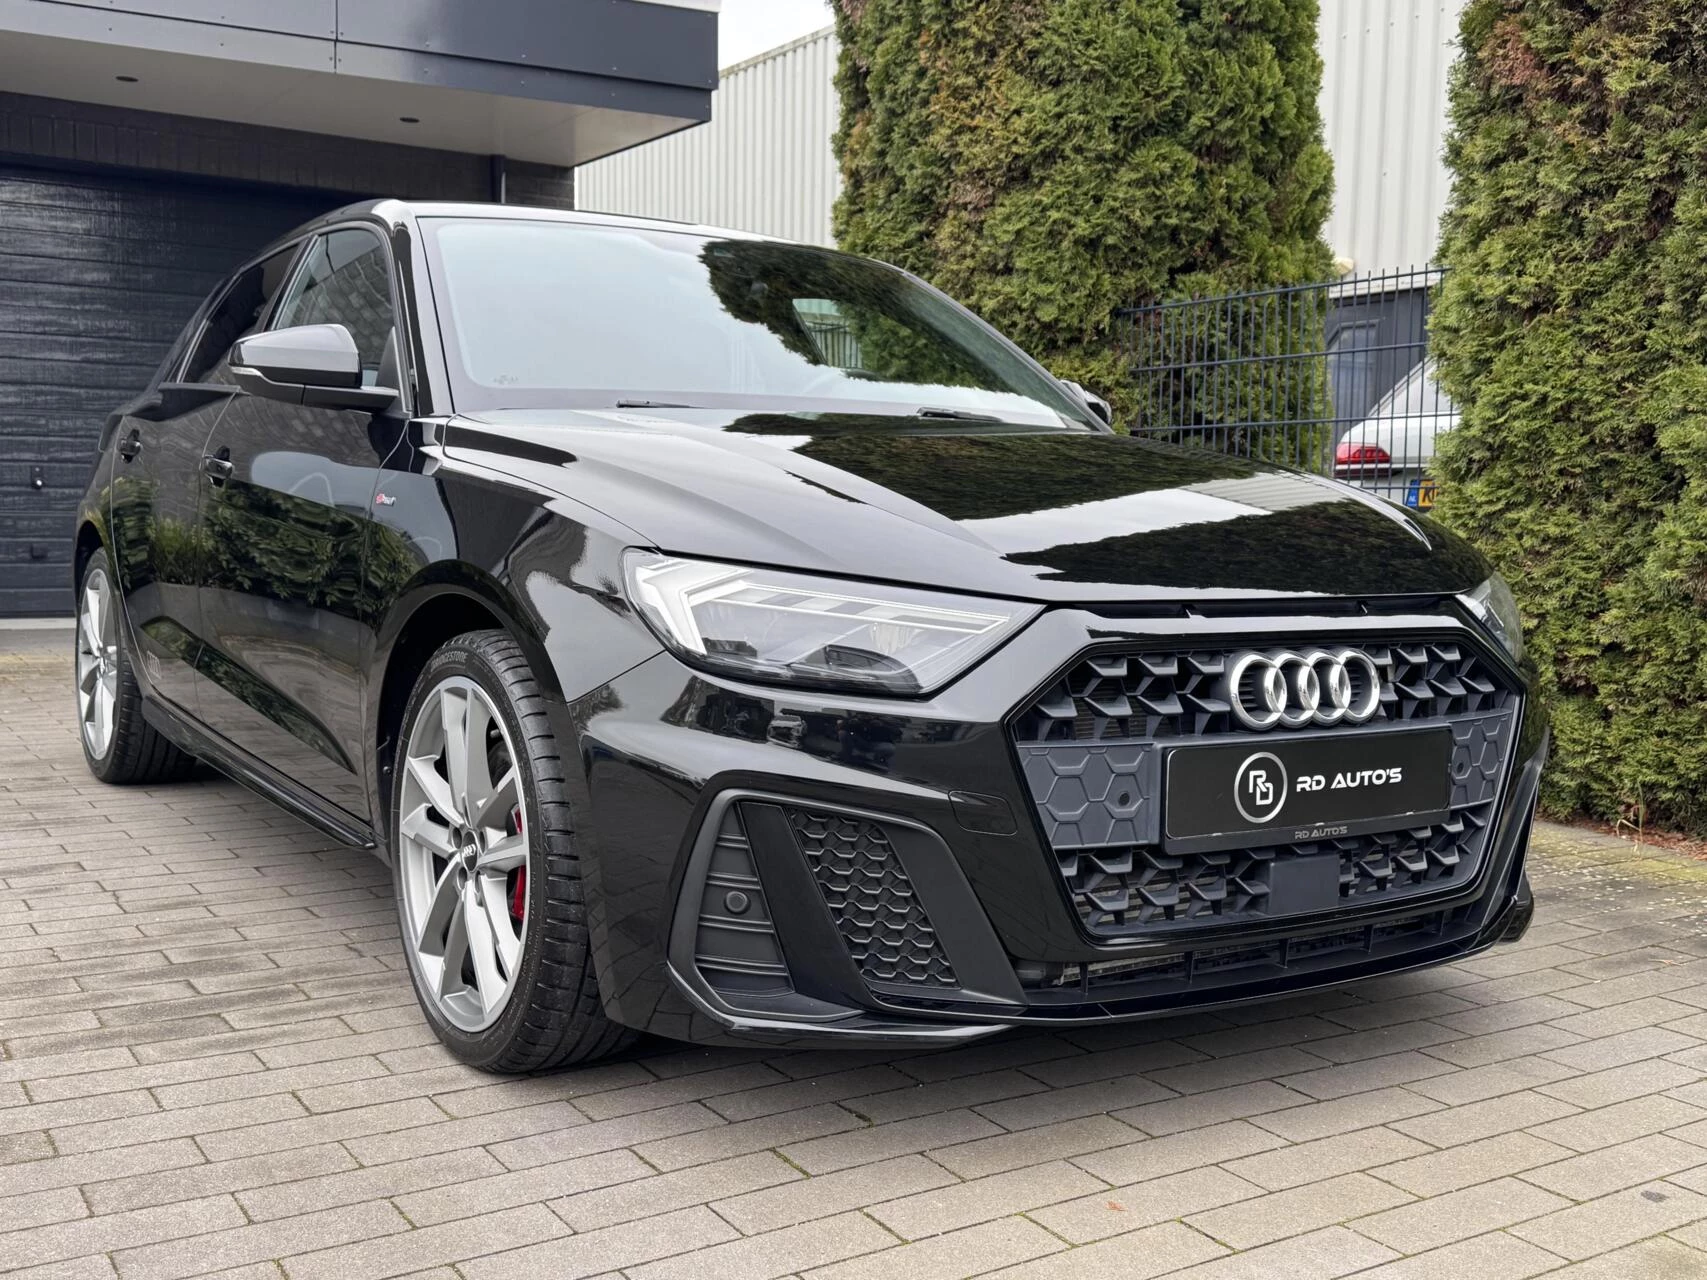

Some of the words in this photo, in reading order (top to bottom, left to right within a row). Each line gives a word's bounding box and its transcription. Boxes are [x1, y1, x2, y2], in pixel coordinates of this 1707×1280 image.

[1296, 775, 1326, 792] RD
[1330, 767, 1402, 789] AUTO'S
[1295, 830, 1310, 839] RD
[1311, 826, 1348, 838] AUTO'S
